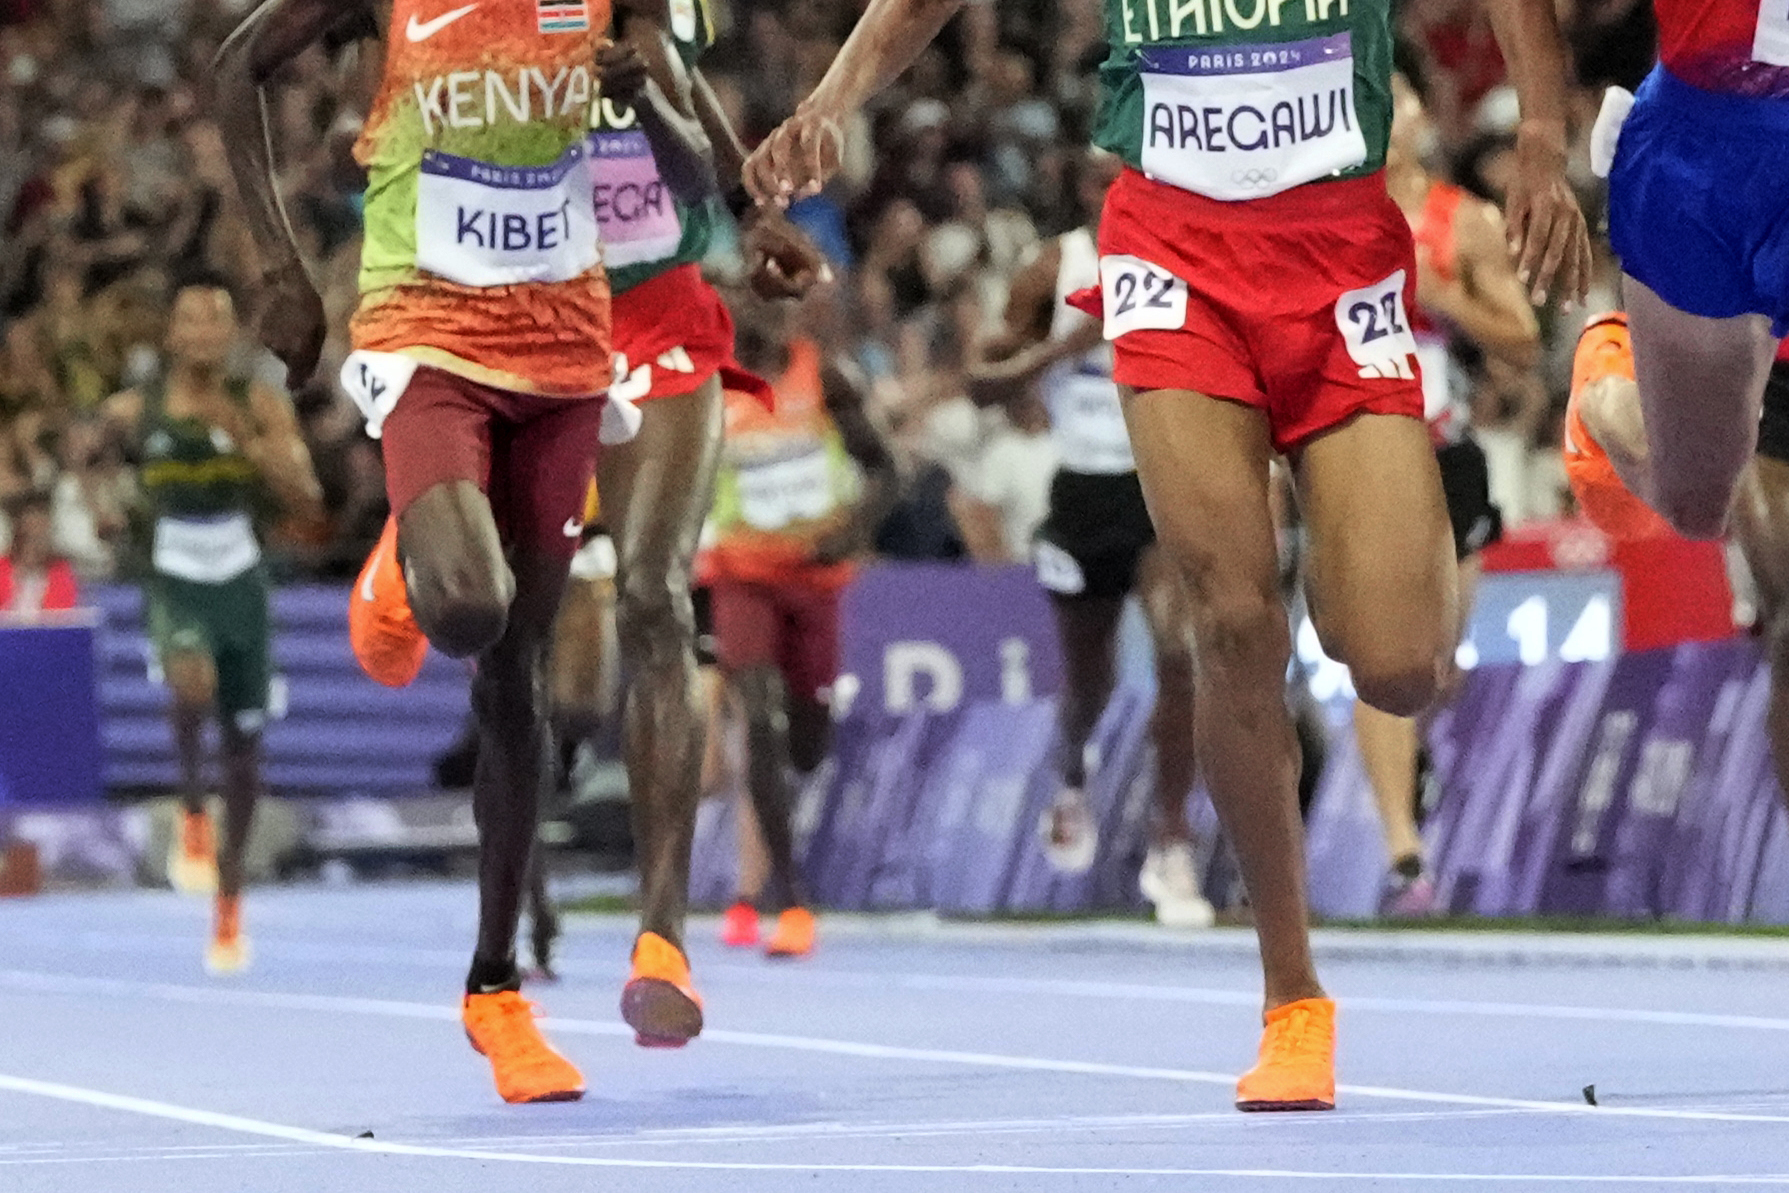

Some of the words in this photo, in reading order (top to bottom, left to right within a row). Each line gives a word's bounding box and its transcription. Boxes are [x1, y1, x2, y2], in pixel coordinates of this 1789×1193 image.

[1188, 53, 1244, 70] PARIS
[1251, 48, 1302, 68] 2024
[414, 64, 592, 137] KENYA
[1149, 87, 1352, 153] AREGAWI
[1114, 271, 1175, 317] 22
